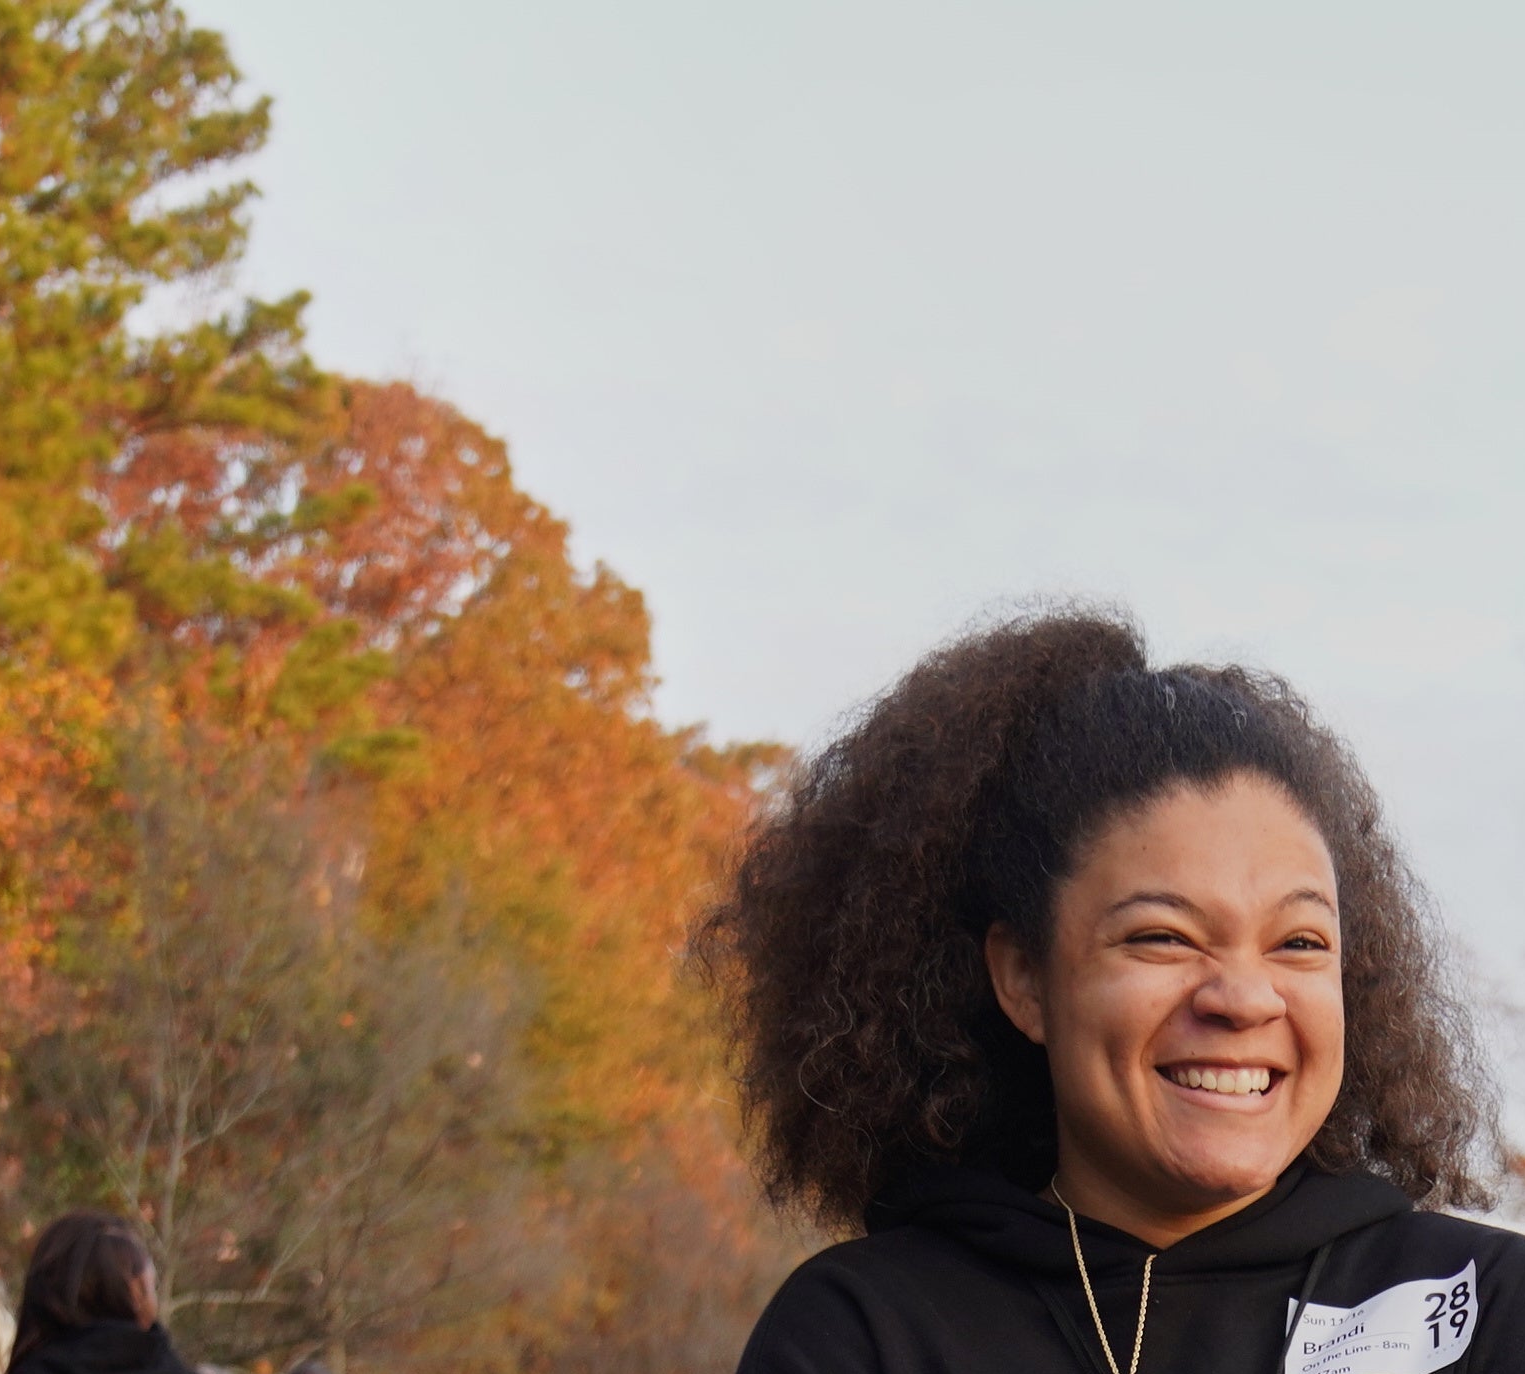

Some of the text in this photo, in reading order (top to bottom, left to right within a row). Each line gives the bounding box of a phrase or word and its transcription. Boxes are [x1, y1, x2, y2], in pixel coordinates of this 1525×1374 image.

[1424, 1280, 1470, 1322] 28
[1302, 1312, 1326, 1327] Sun
[1427, 1309, 1469, 1349] 19
[1303, 1322, 1365, 1355] Brandi
[1302, 1360, 1321, 1373] On
[1322, 1350, 1342, 1365] the
[1345, 1342, 1372, 1356] Line
[1382, 1339, 1411, 1351] 8am
